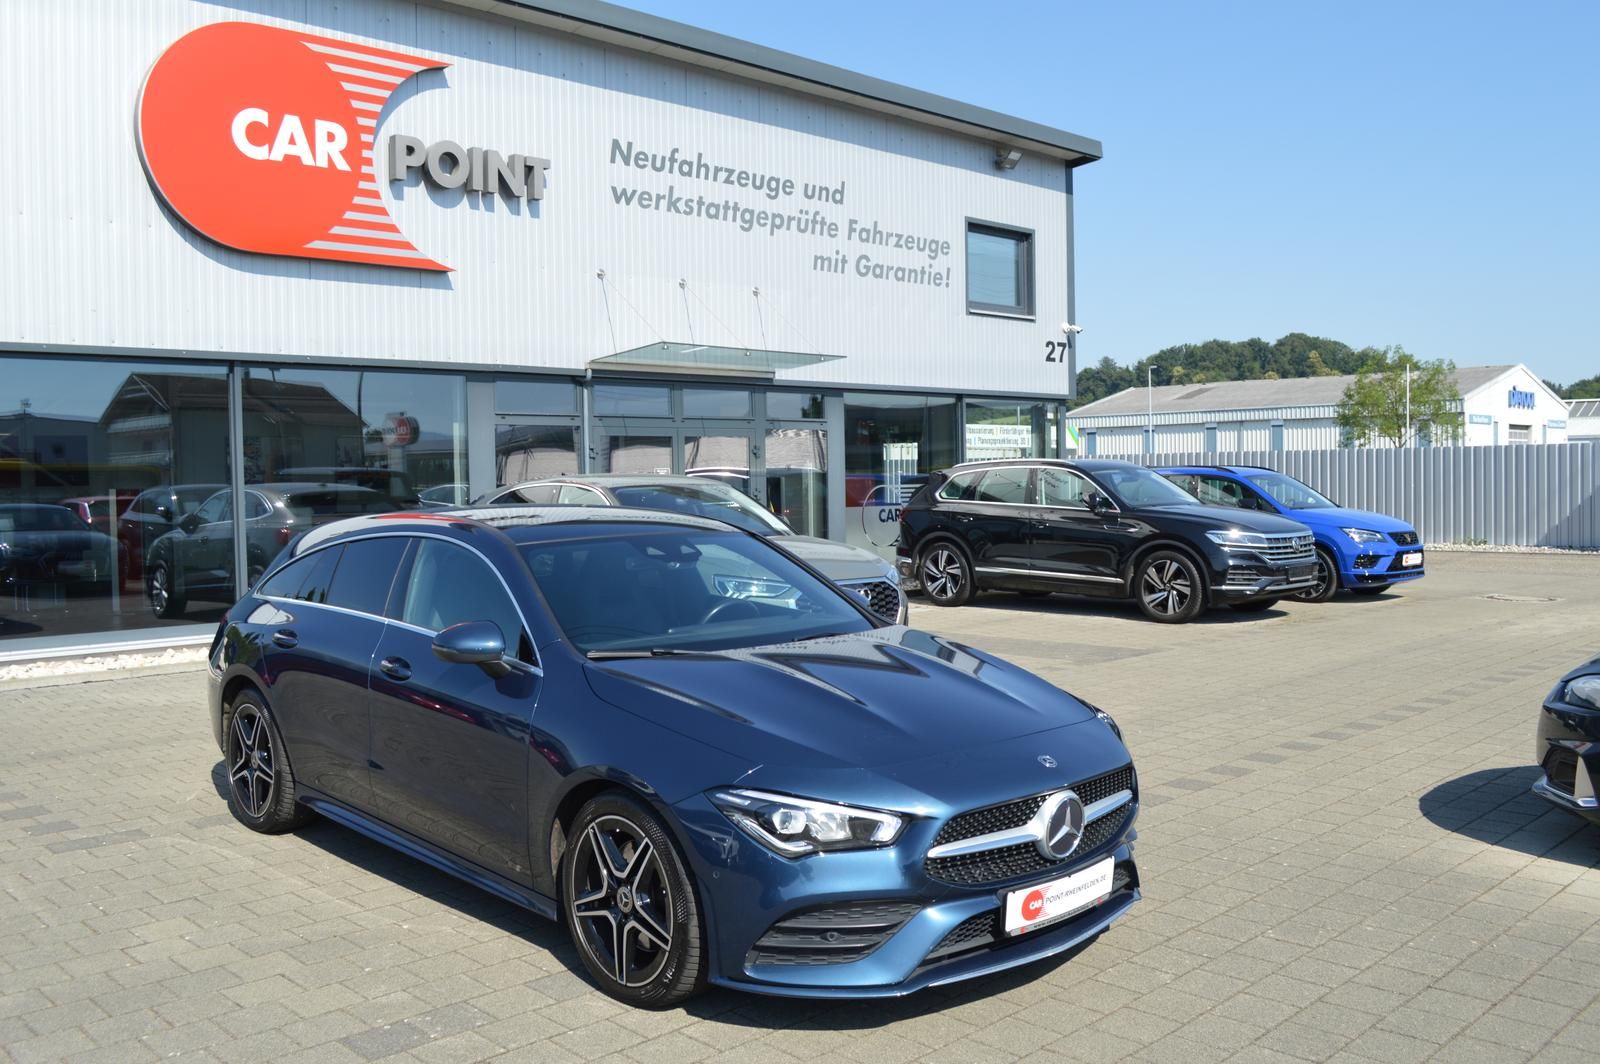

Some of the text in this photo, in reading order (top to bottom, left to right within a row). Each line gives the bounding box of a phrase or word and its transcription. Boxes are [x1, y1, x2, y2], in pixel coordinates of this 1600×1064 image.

[231, 107, 551, 202] CAR POINT
[610, 138, 846, 205] Neufahrzeuge und
[610, 185, 951, 260] werkstattgeprüfte Fahrzeuge
[813, 249, 951, 289] mit Garantie!
[1045, 340, 1067, 363] 27
[1029, 898, 1043, 910] CAR
